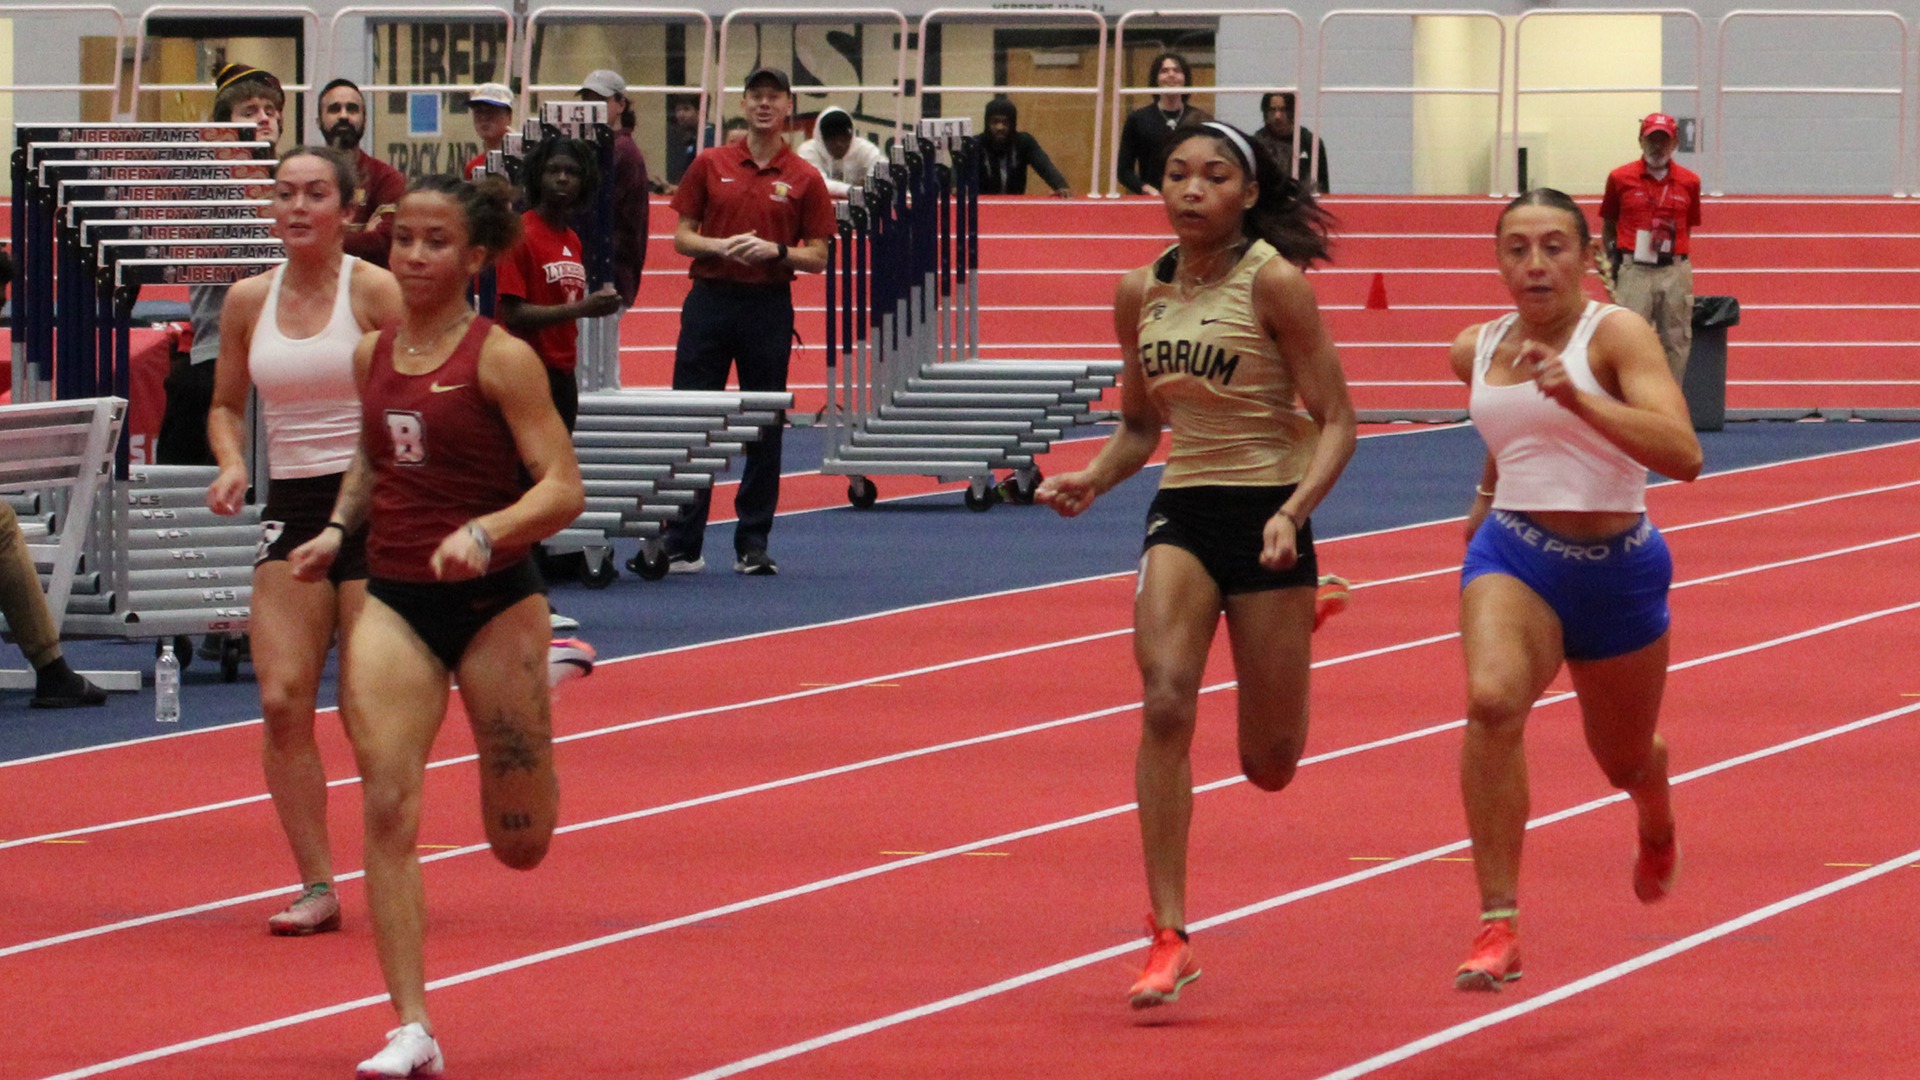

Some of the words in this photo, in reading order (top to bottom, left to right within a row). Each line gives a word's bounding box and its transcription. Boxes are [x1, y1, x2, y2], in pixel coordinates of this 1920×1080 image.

[73, 130, 139, 142] LIBERTY
[102, 167, 169, 180] LIBERTY
[118, 187, 186, 200] LIBERTY
[188, 187, 245, 200] FLAMES
[130, 208, 197, 219] LIBERTY
[142, 227, 210, 239] LIBERTY
[159, 247, 227, 258] LIBERTY
[177, 266, 247, 283] LIBERTY
[1495, 511, 1542, 546] NIKE
[1543, 538, 1610, 561] PRO
[203, 591, 236, 602] UCS
